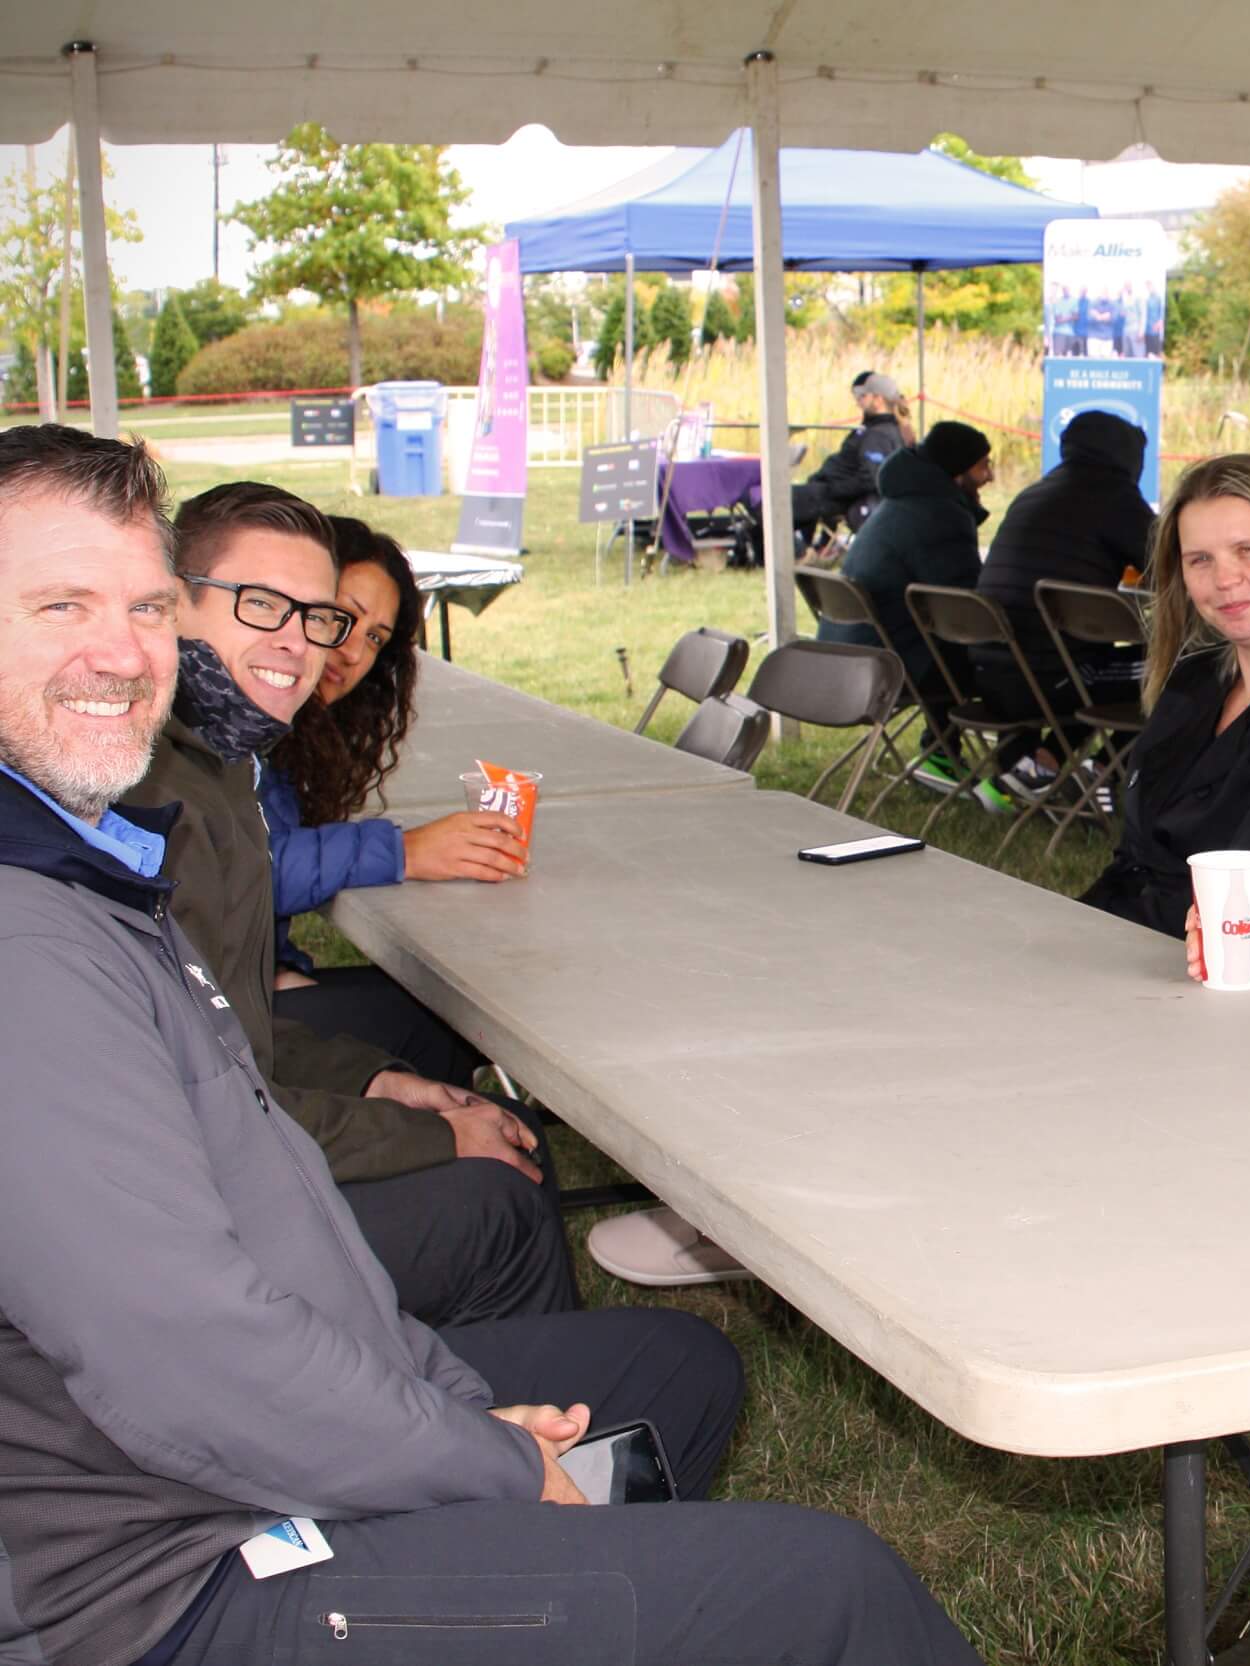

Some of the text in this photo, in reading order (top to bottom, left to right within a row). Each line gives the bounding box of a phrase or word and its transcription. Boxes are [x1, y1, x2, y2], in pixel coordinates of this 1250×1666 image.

[1092, 243, 1143, 257] Allies
[1053, 378, 1064, 389] IN
[1066, 378, 1089, 390] YOUR
[1091, 379, 1142, 391] COMMUNITY
